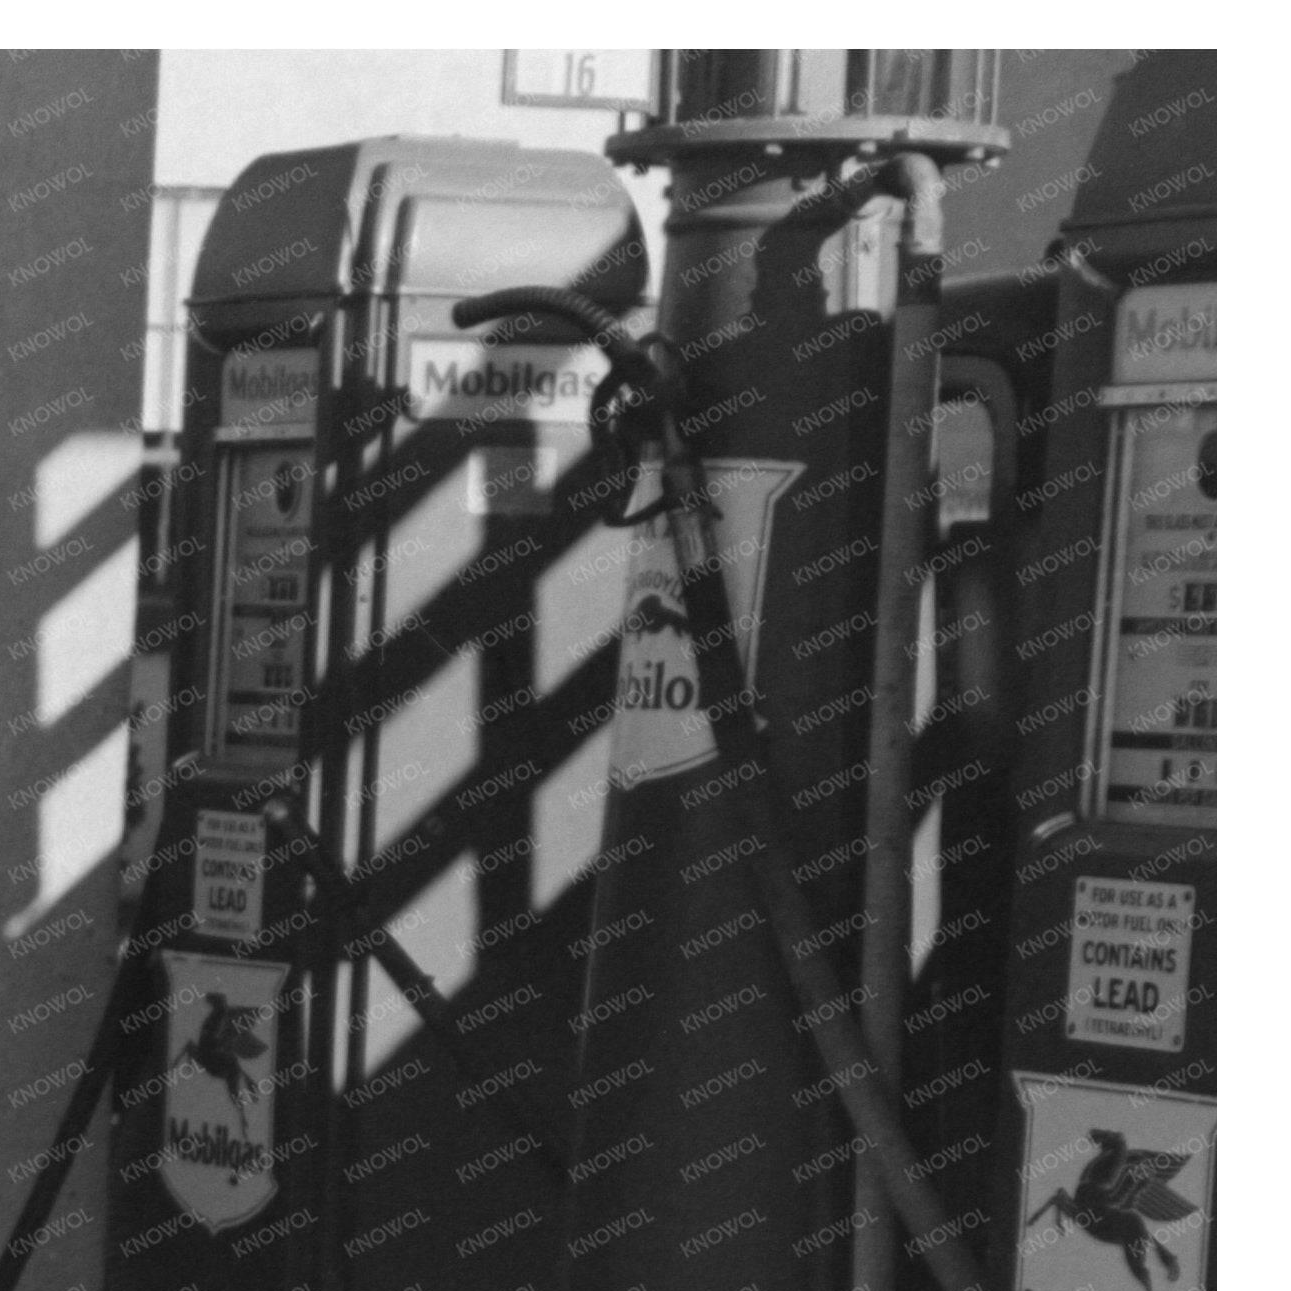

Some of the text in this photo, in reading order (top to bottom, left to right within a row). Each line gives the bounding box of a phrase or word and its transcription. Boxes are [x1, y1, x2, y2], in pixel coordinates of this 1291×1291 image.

[564, 53, 596, 97] 16
[1125, 300, 1216, 354] Mobi
[209, 885, 247, 913] LEAD
[1092, 887, 1177, 909] FOR USE AS A
[1123, 914, 1153, 932] FUEL
[1083, 940, 1177, 973] CONTAINS
[1093, 976, 1160, 1014] LEAD
[169, 1117, 264, 1186] Mobilgas
